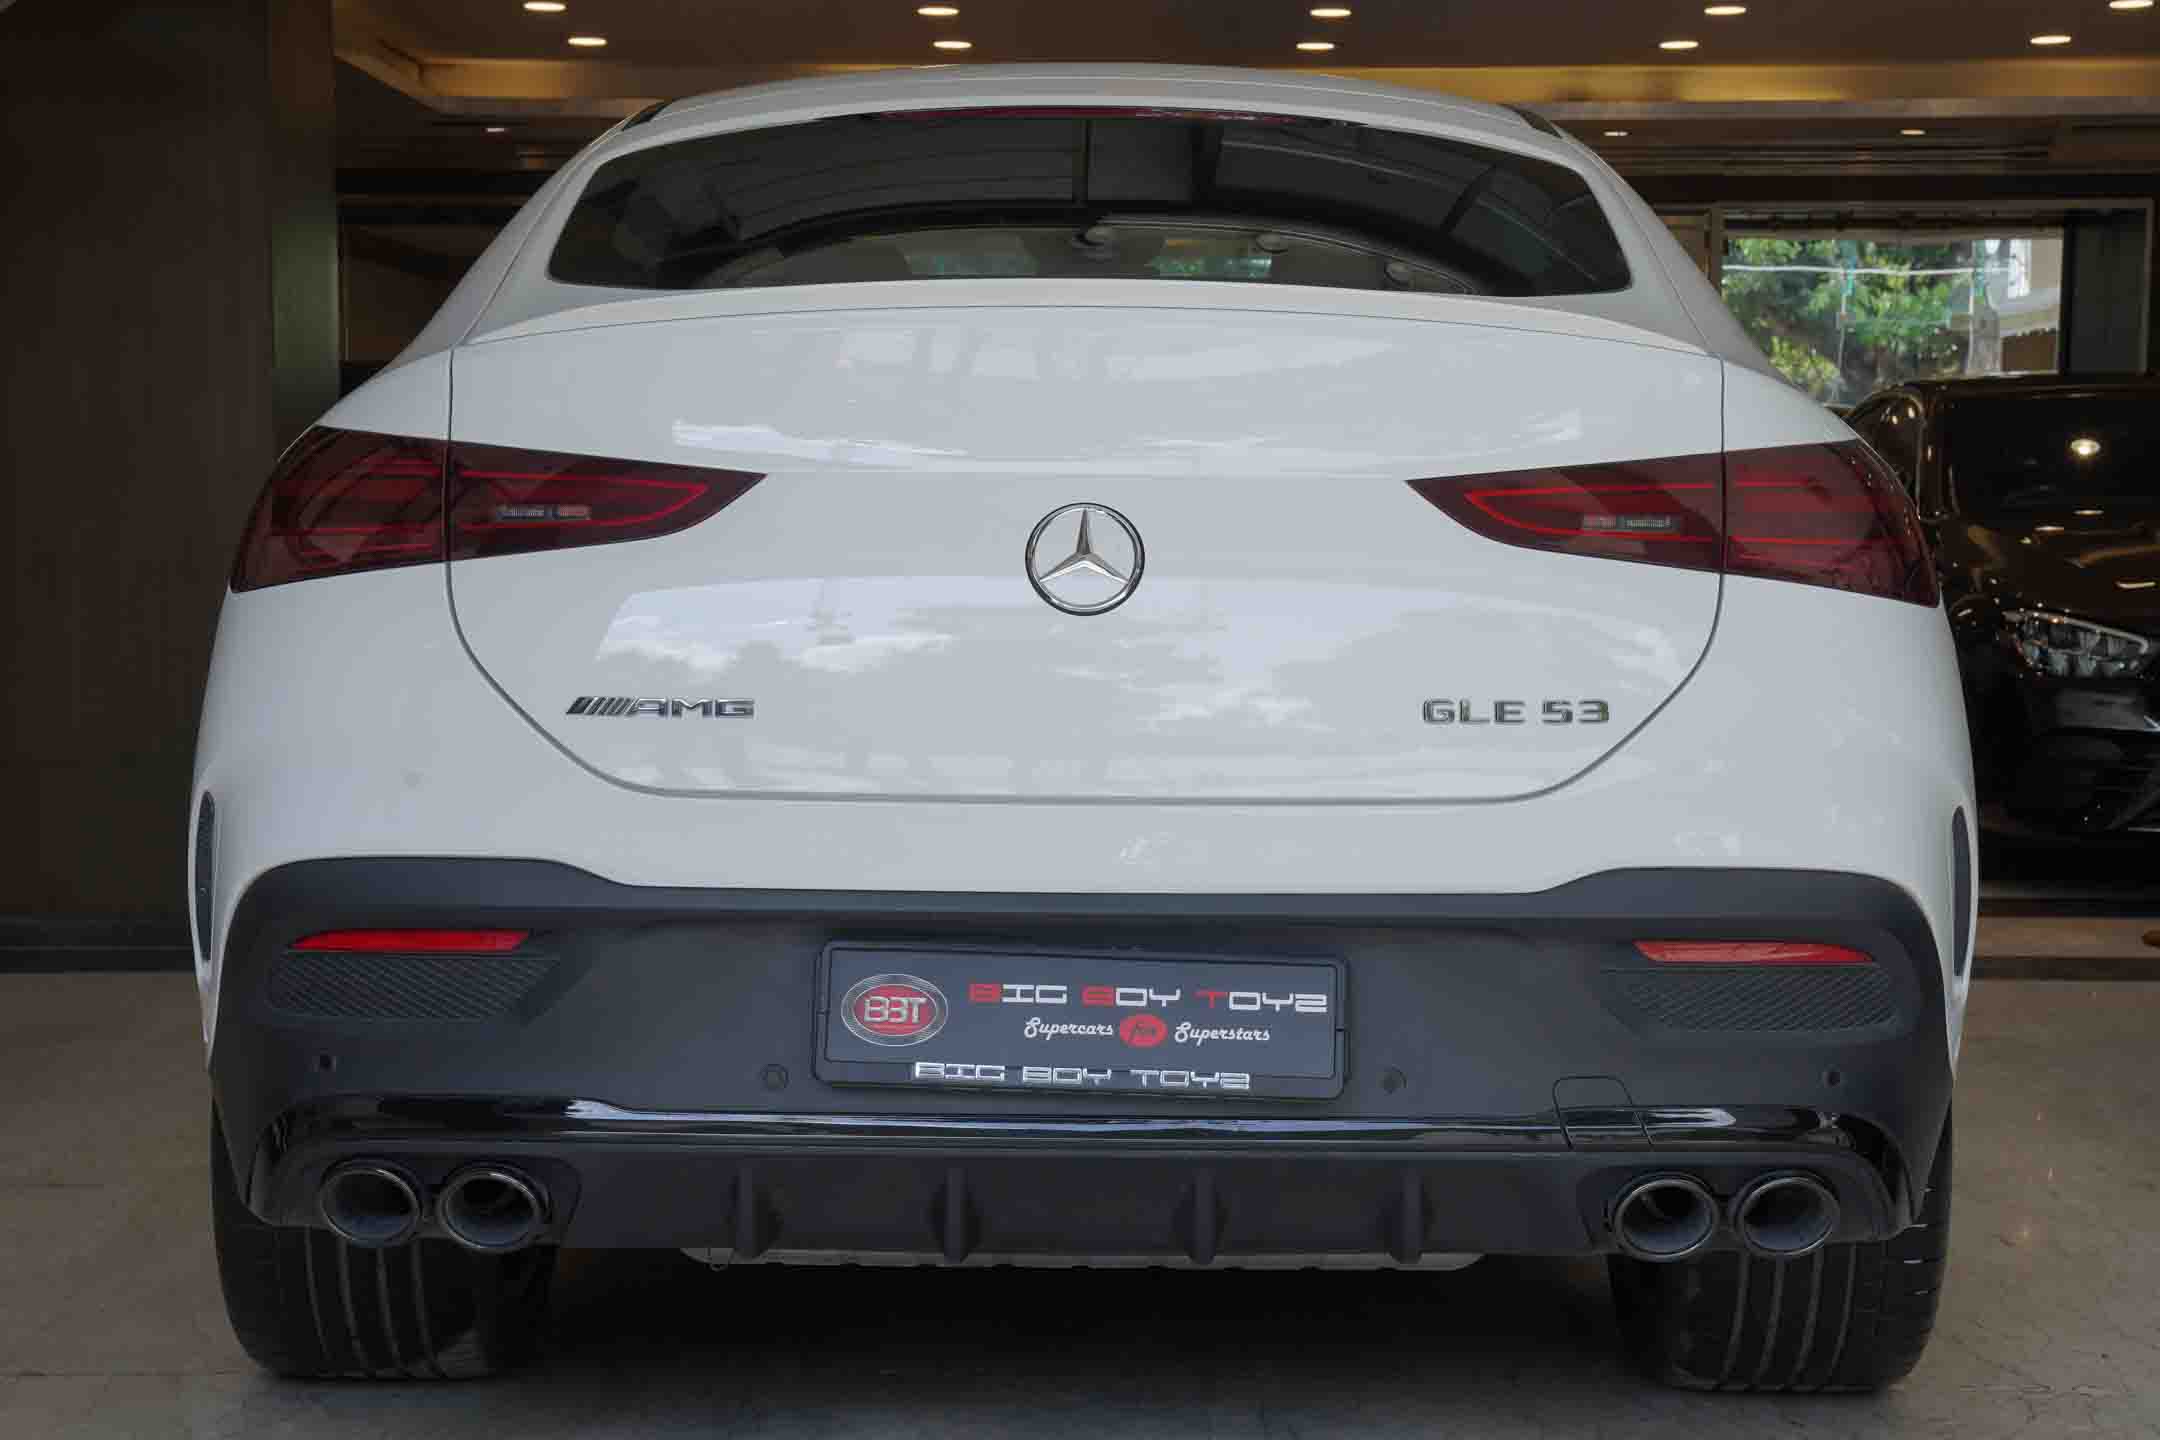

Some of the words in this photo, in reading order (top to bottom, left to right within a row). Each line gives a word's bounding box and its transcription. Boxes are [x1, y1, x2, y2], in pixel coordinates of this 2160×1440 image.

[630, 697, 755, 717] AMG
[1422, 699, 1526, 724] GLE
[1541, 699, 1610, 724] 53
[968, 983, 1068, 1005] BIG
[1081, 985, 1182, 1008] BOY
[1023, 1016, 1113, 1041] Supercars
[1174, 1021, 1270, 1046] Superstars
[914, 1062, 1006, 1081] BIG
[1021, 1066, 1112, 1087] BOY
